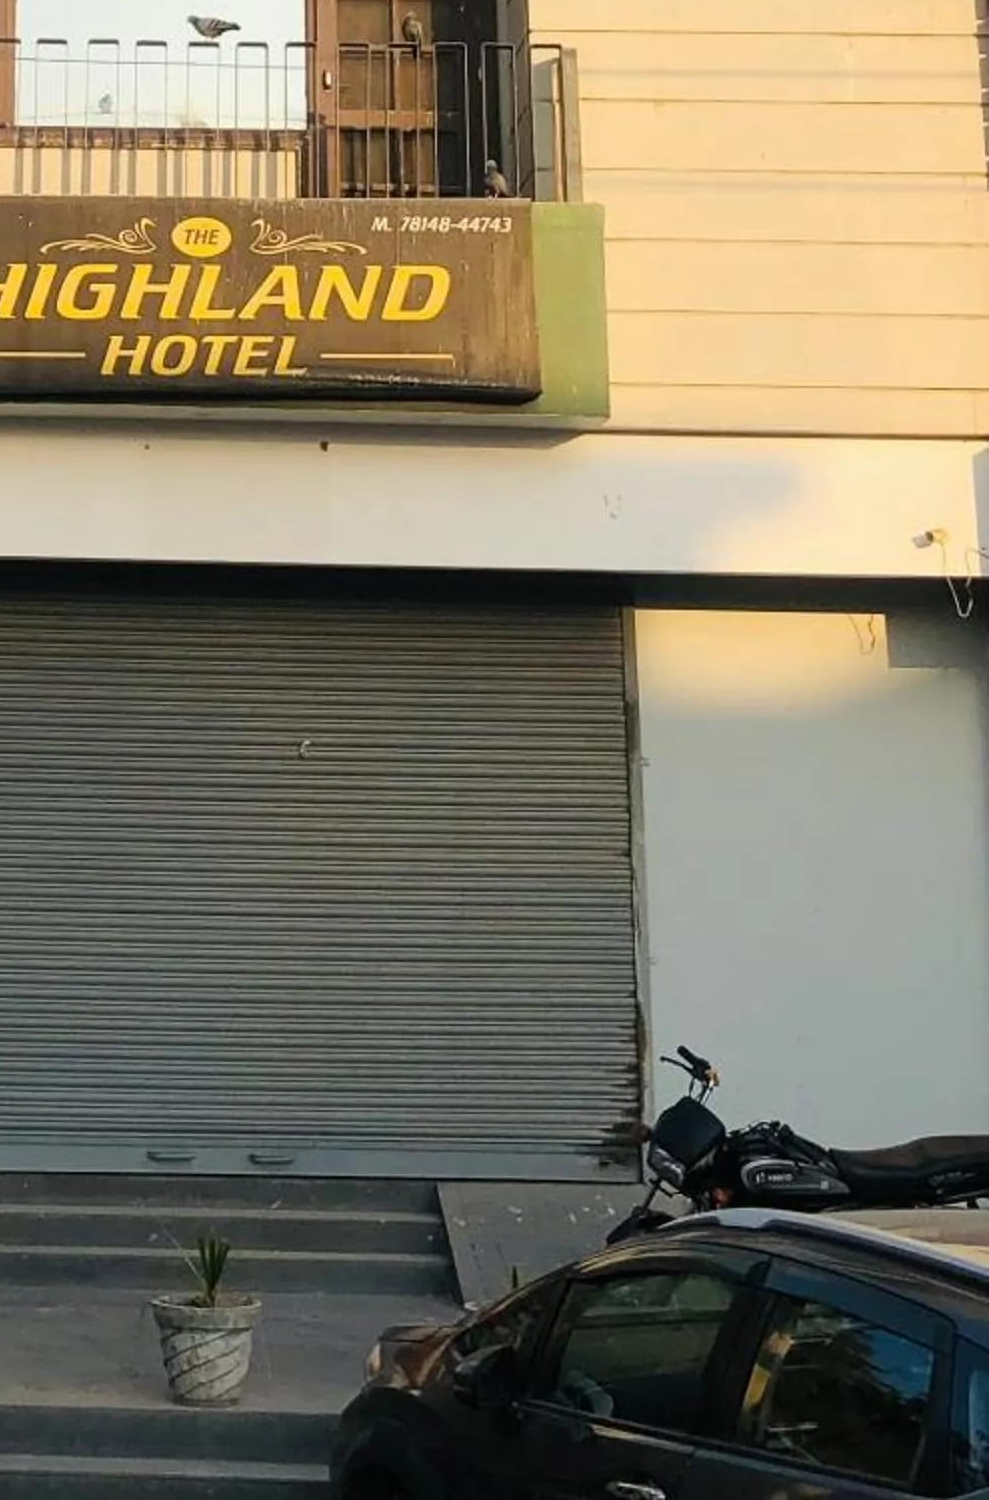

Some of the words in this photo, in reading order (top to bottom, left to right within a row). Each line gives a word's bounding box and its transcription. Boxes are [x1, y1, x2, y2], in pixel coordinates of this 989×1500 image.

[370, 216, 393, 232] M.
[399, 215, 512, 233] 78148-44743
[184, 227, 220, 246] THE
[100, 334, 309, 377] HOTEL
